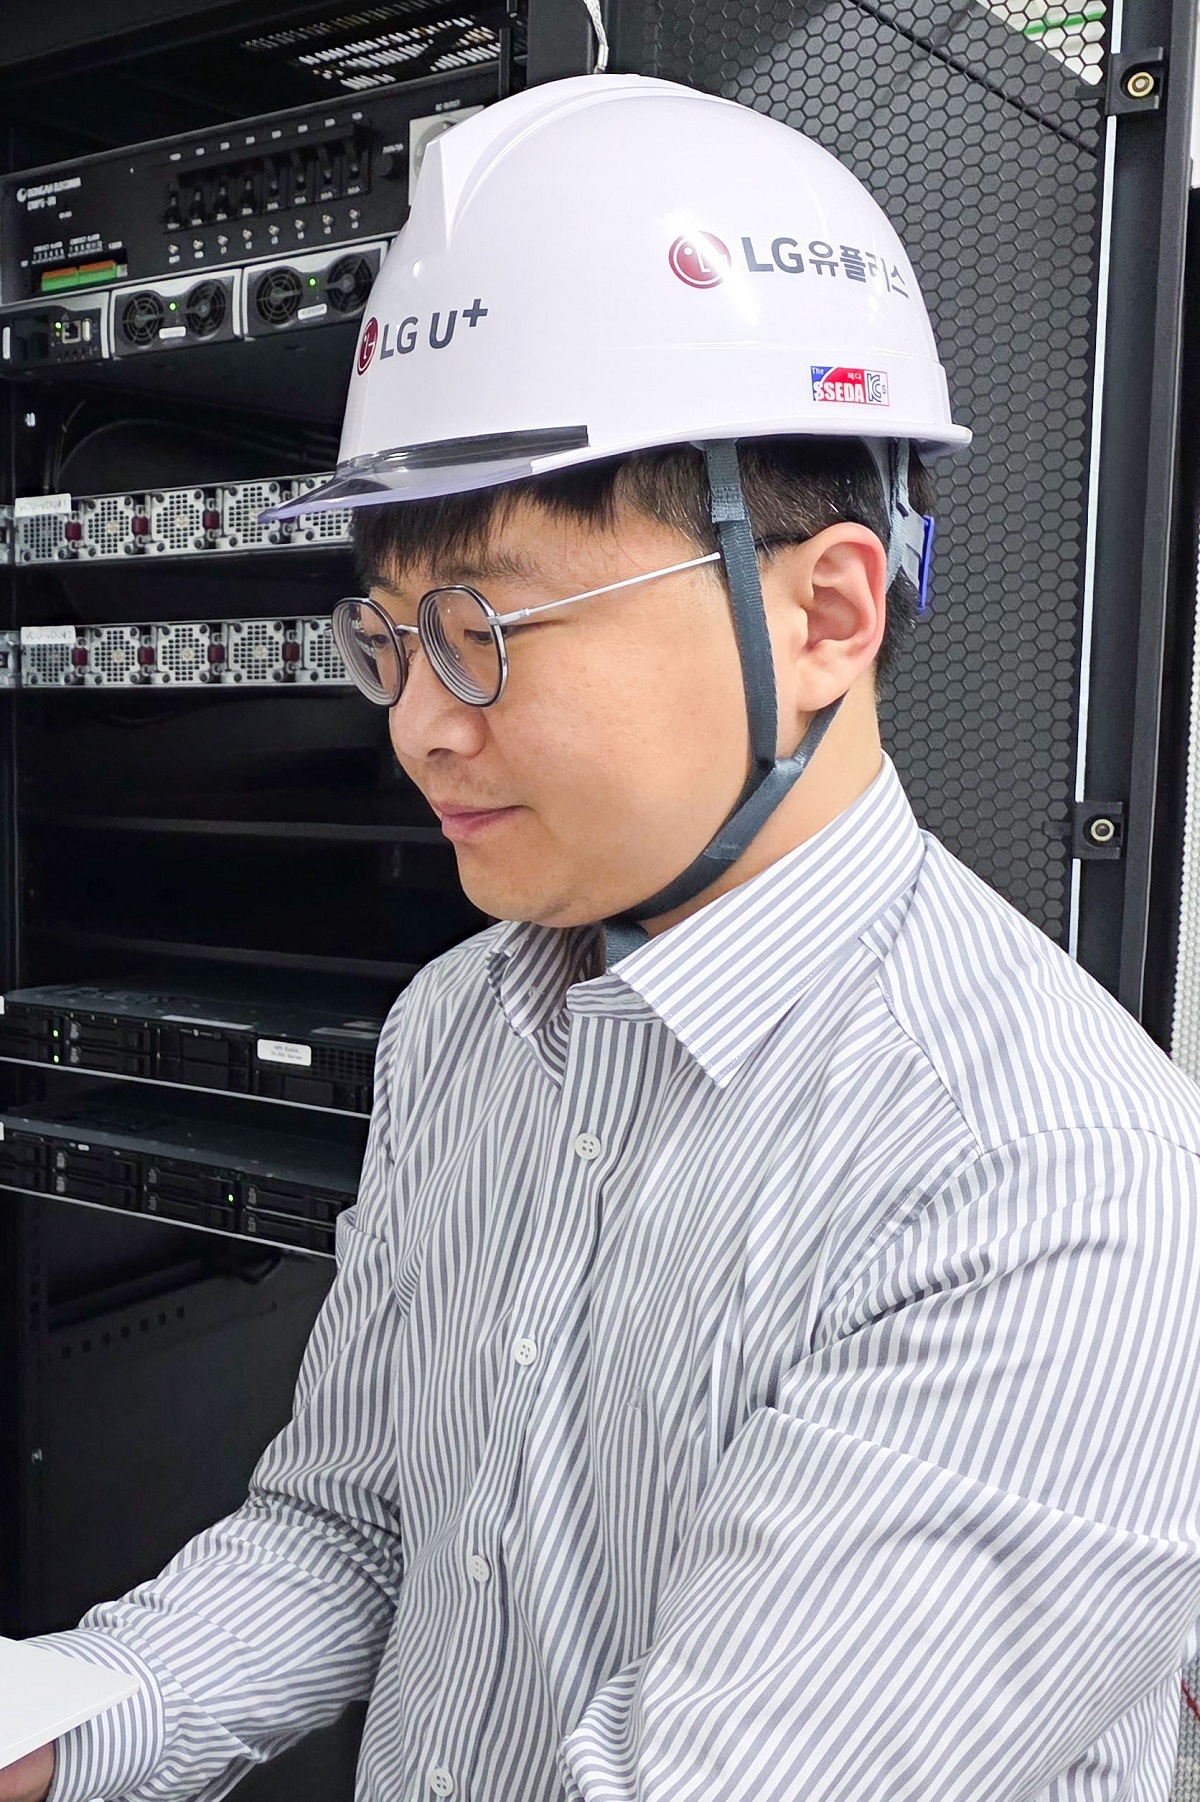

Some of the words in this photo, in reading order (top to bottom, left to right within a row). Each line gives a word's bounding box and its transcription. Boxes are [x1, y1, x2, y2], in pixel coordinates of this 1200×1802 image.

[379, 316, 419, 360] LG
[429, 298, 489, 350] U+
[812, 367, 825, 375] The
[812, 380, 865, 403] SSEDA
